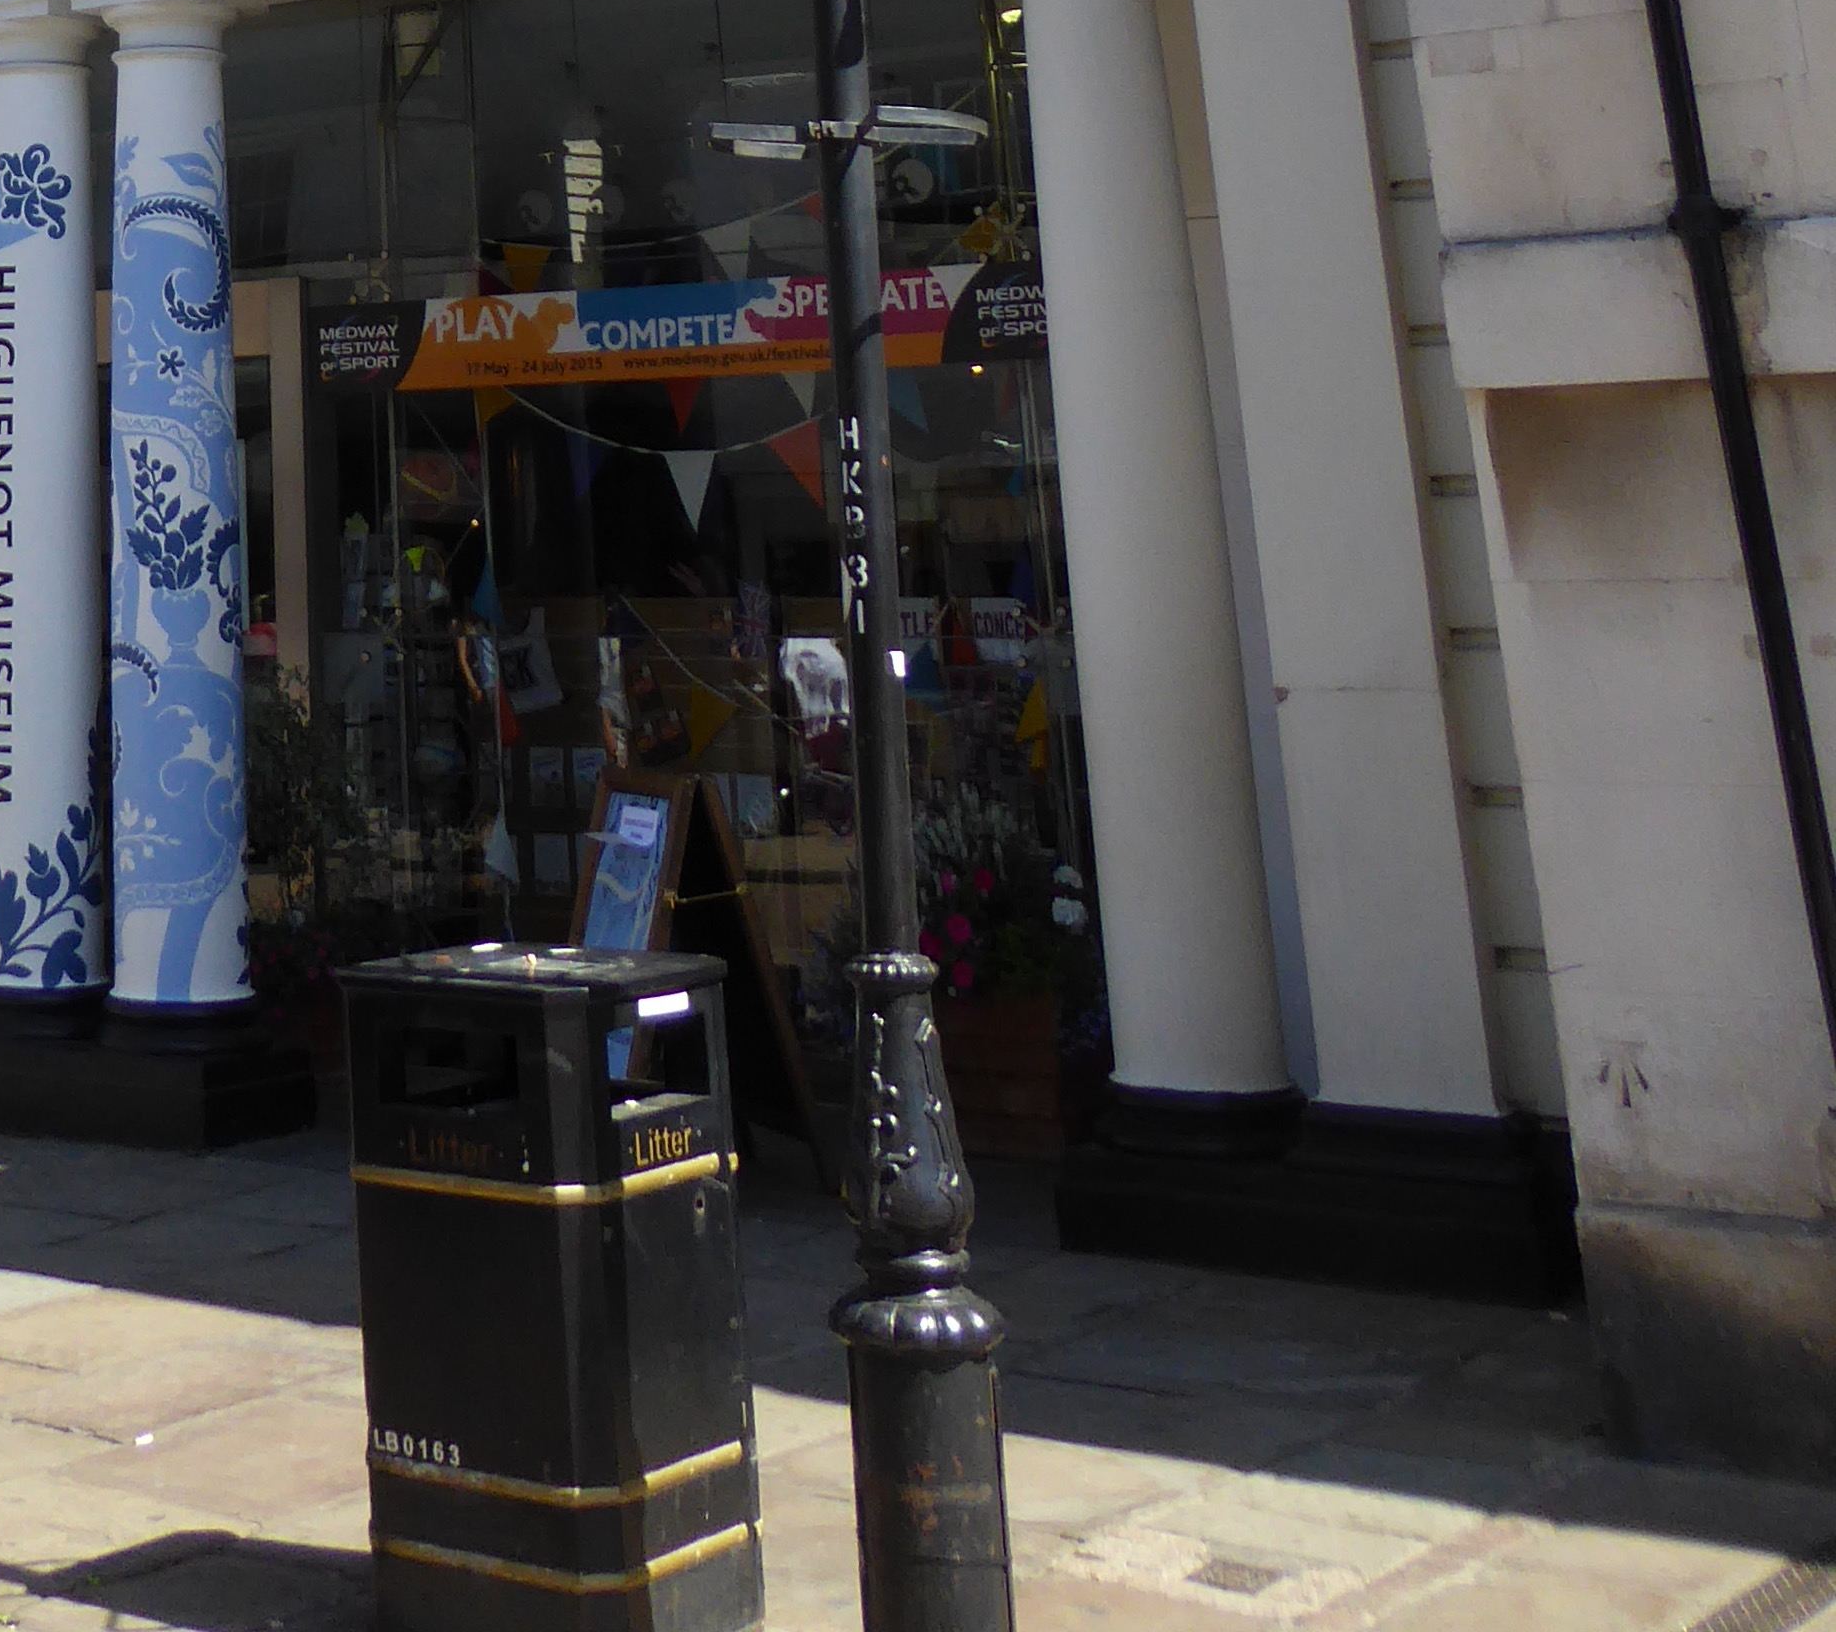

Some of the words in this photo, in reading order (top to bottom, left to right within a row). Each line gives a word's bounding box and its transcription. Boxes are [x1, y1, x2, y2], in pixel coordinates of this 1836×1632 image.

[777, 277, 946, 318] SPEATE
[975, 285, 1044, 303] MEDW
[977, 303, 1047, 320] FESTIV
[319, 324, 399, 341] MEDWAY
[435, 303, 516, 344] PLAY
[582, 312, 735, 352] COMPETE
[1003, 320, 1048, 337] SPO
[319, 340, 400, 356] FESTIVAL
[338, 354, 400, 372] SPORT
[483, 360, 509, 377] May
[569, 356, 603, 371] 2015
[633, 1125, 692, 1168] Litter
[372, 1427, 461, 1468] LB0163
